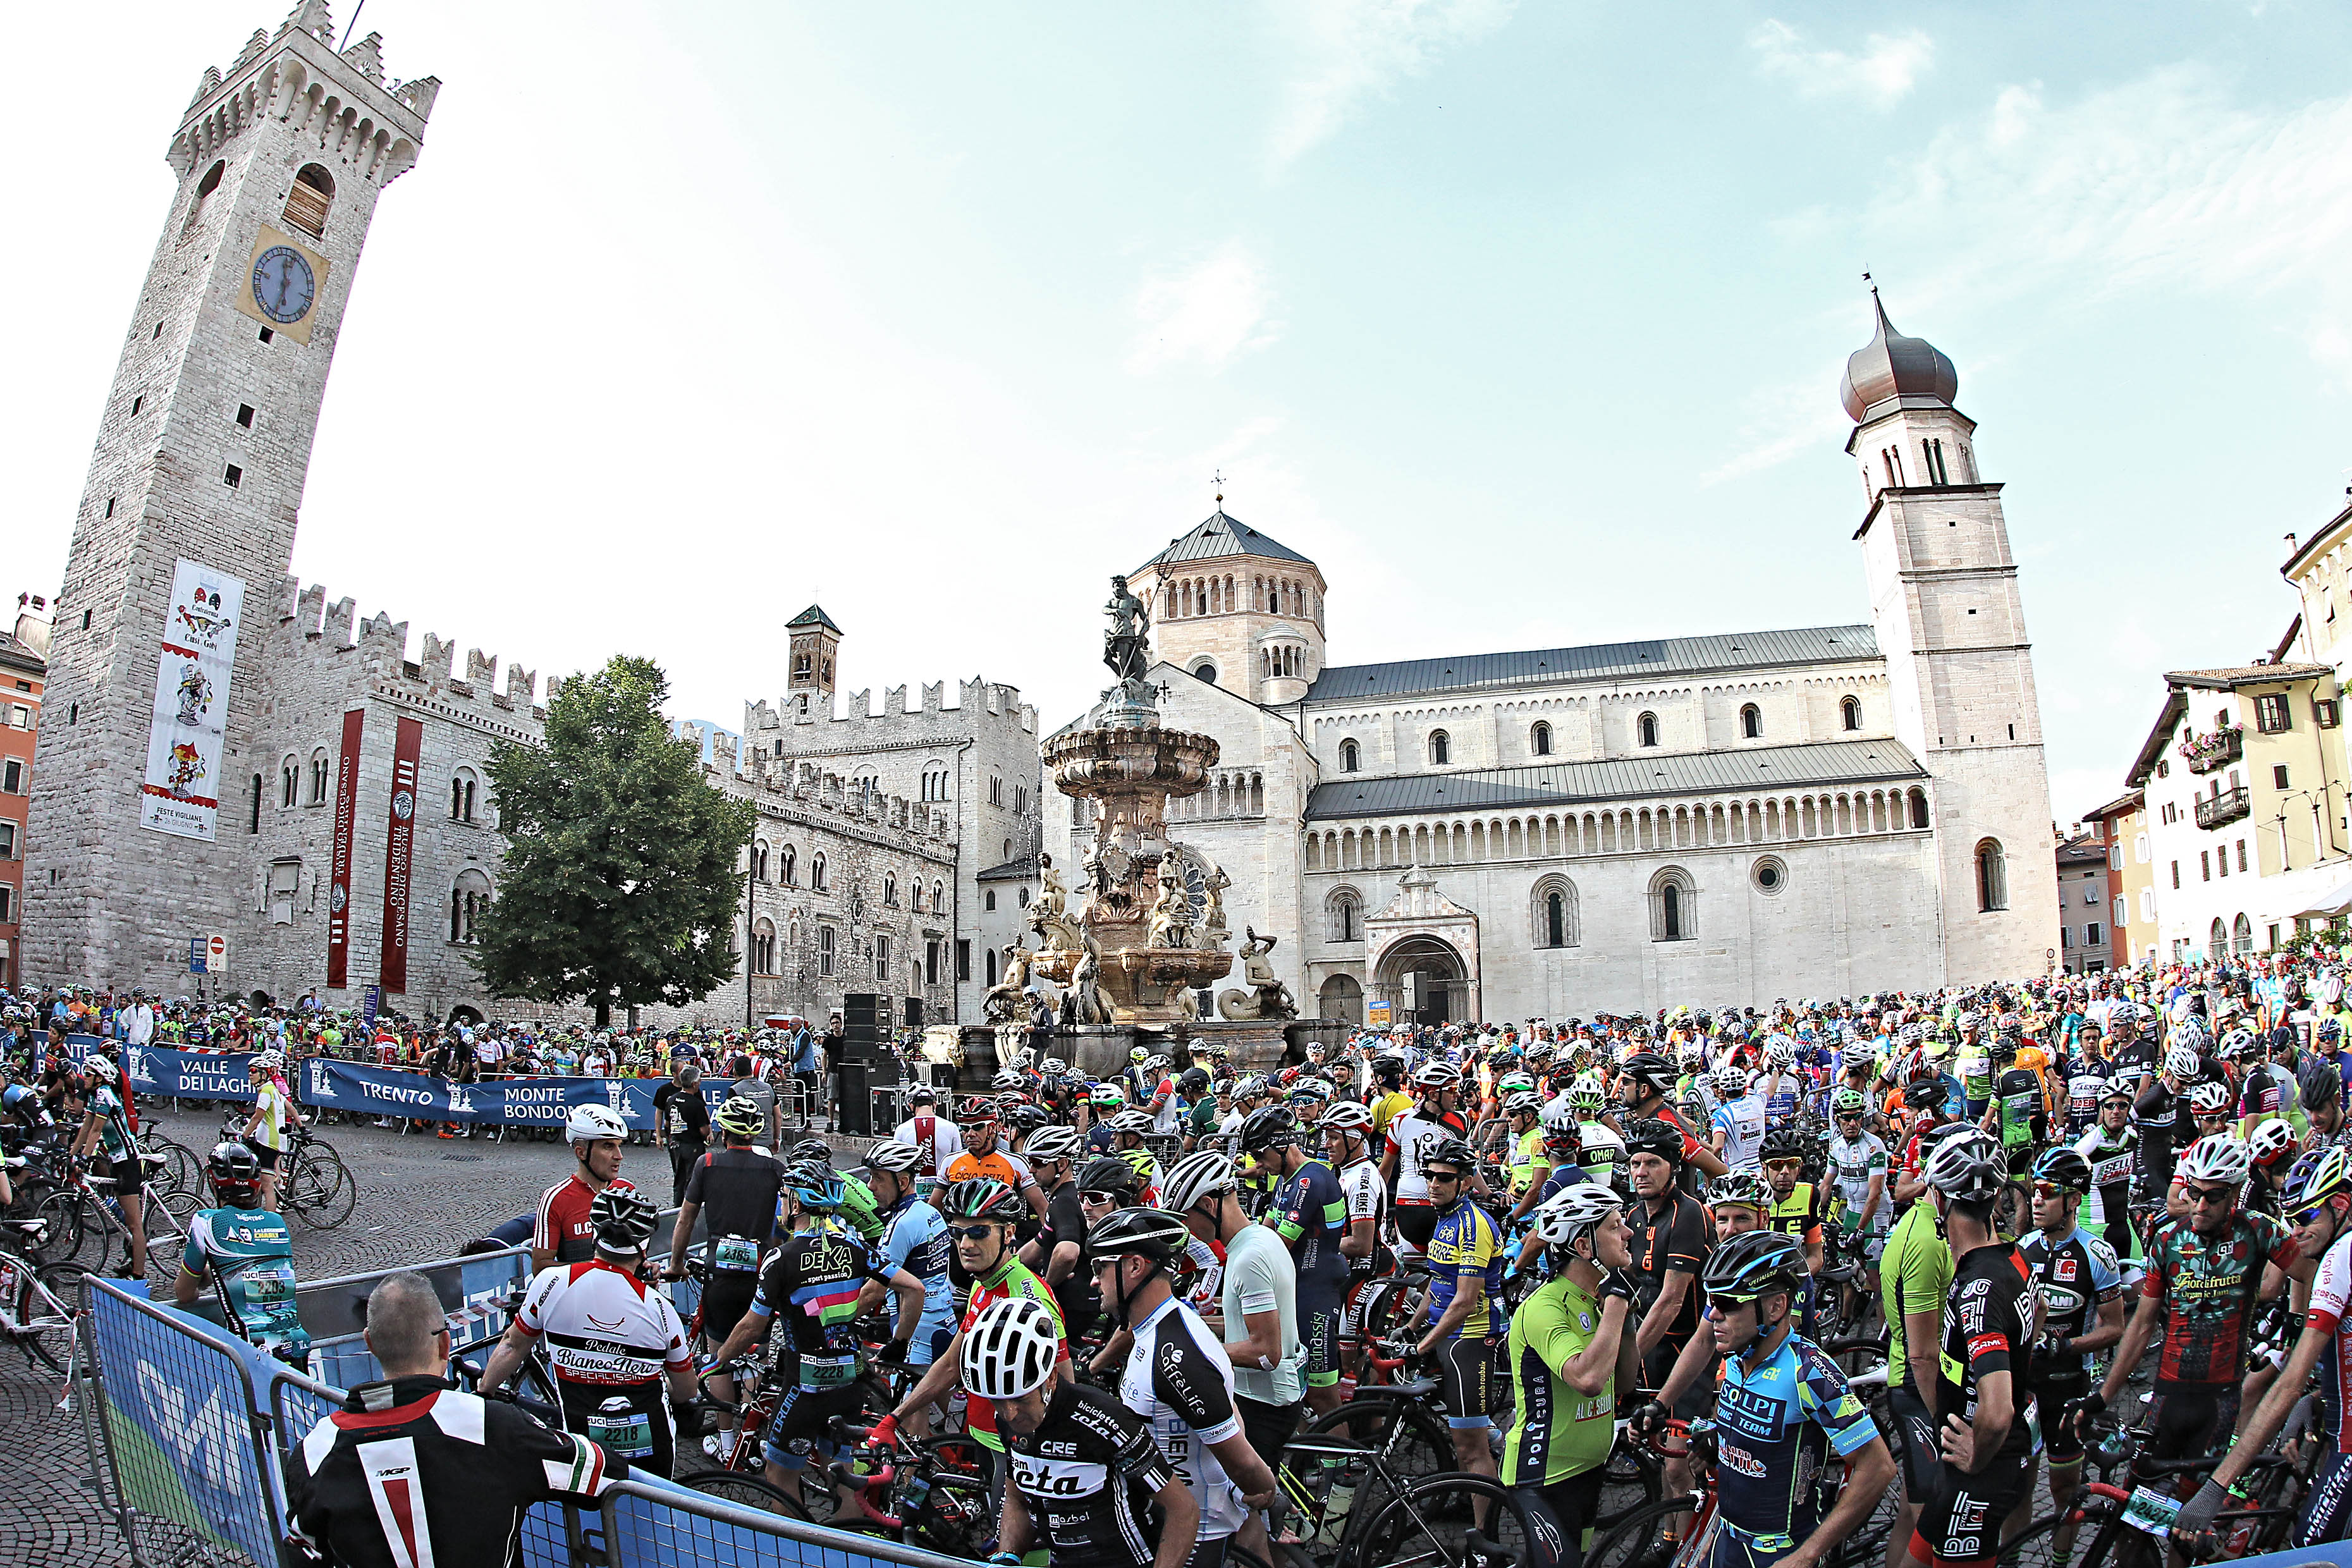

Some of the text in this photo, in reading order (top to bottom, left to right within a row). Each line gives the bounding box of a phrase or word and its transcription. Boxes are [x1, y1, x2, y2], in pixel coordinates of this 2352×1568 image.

[157, 807, 202, 823] FESTE VIGILIANE
[172, 819, 193, 830] GIUGNO
[389, 825, 403, 907] TRIDENTINO
[395, 826, 411, 948] MUSEO DIOCESANO
[37, 1040, 91, 1058] MNTE
[180, 1060, 228, 1075] VALLE
[179, 1075, 204, 1091] DEI
[358, 1080, 434, 1106] TRENTO
[505, 1087, 565, 1103] MONTE
[954, 1172, 979, 1181] CICLO
[2072, 1177, 2084, 1186] sky
[1171, 1181, 1182, 1197] GIRO
[1297, 1190, 1307, 1210] BRIGHT
[1359, 1192, 1368, 1213] BIKE
[723, 1248, 750, 1262] 2385
[800, 1245, 852, 1271] DEKA
[258, 1280, 285, 1295] 2203
[1356, 1282, 1373, 1305] BIKE
[1309, 1311, 1326, 1360] dnassist
[585, 1339, 627, 1356] Pedale
[812, 1366, 844, 1379] 2228
[774, 1385, 802, 1435] DROMO
[1077, 1400, 1120, 1431] biciclette
[2025, 1402, 2035, 1417] UCI
[592, 1417, 605, 1426] UCI
[1739, 1417, 1772, 1436] TEAM
[604, 1426, 638, 1442] 2218
[1041, 1441, 1077, 1455] CRE
[375, 1466, 411, 1478] MGP
[1012, 1457, 1029, 1471] eam
[1959, 1502, 1971, 1527] CYCLING
[2133, 1499, 2168, 1518] 2427
